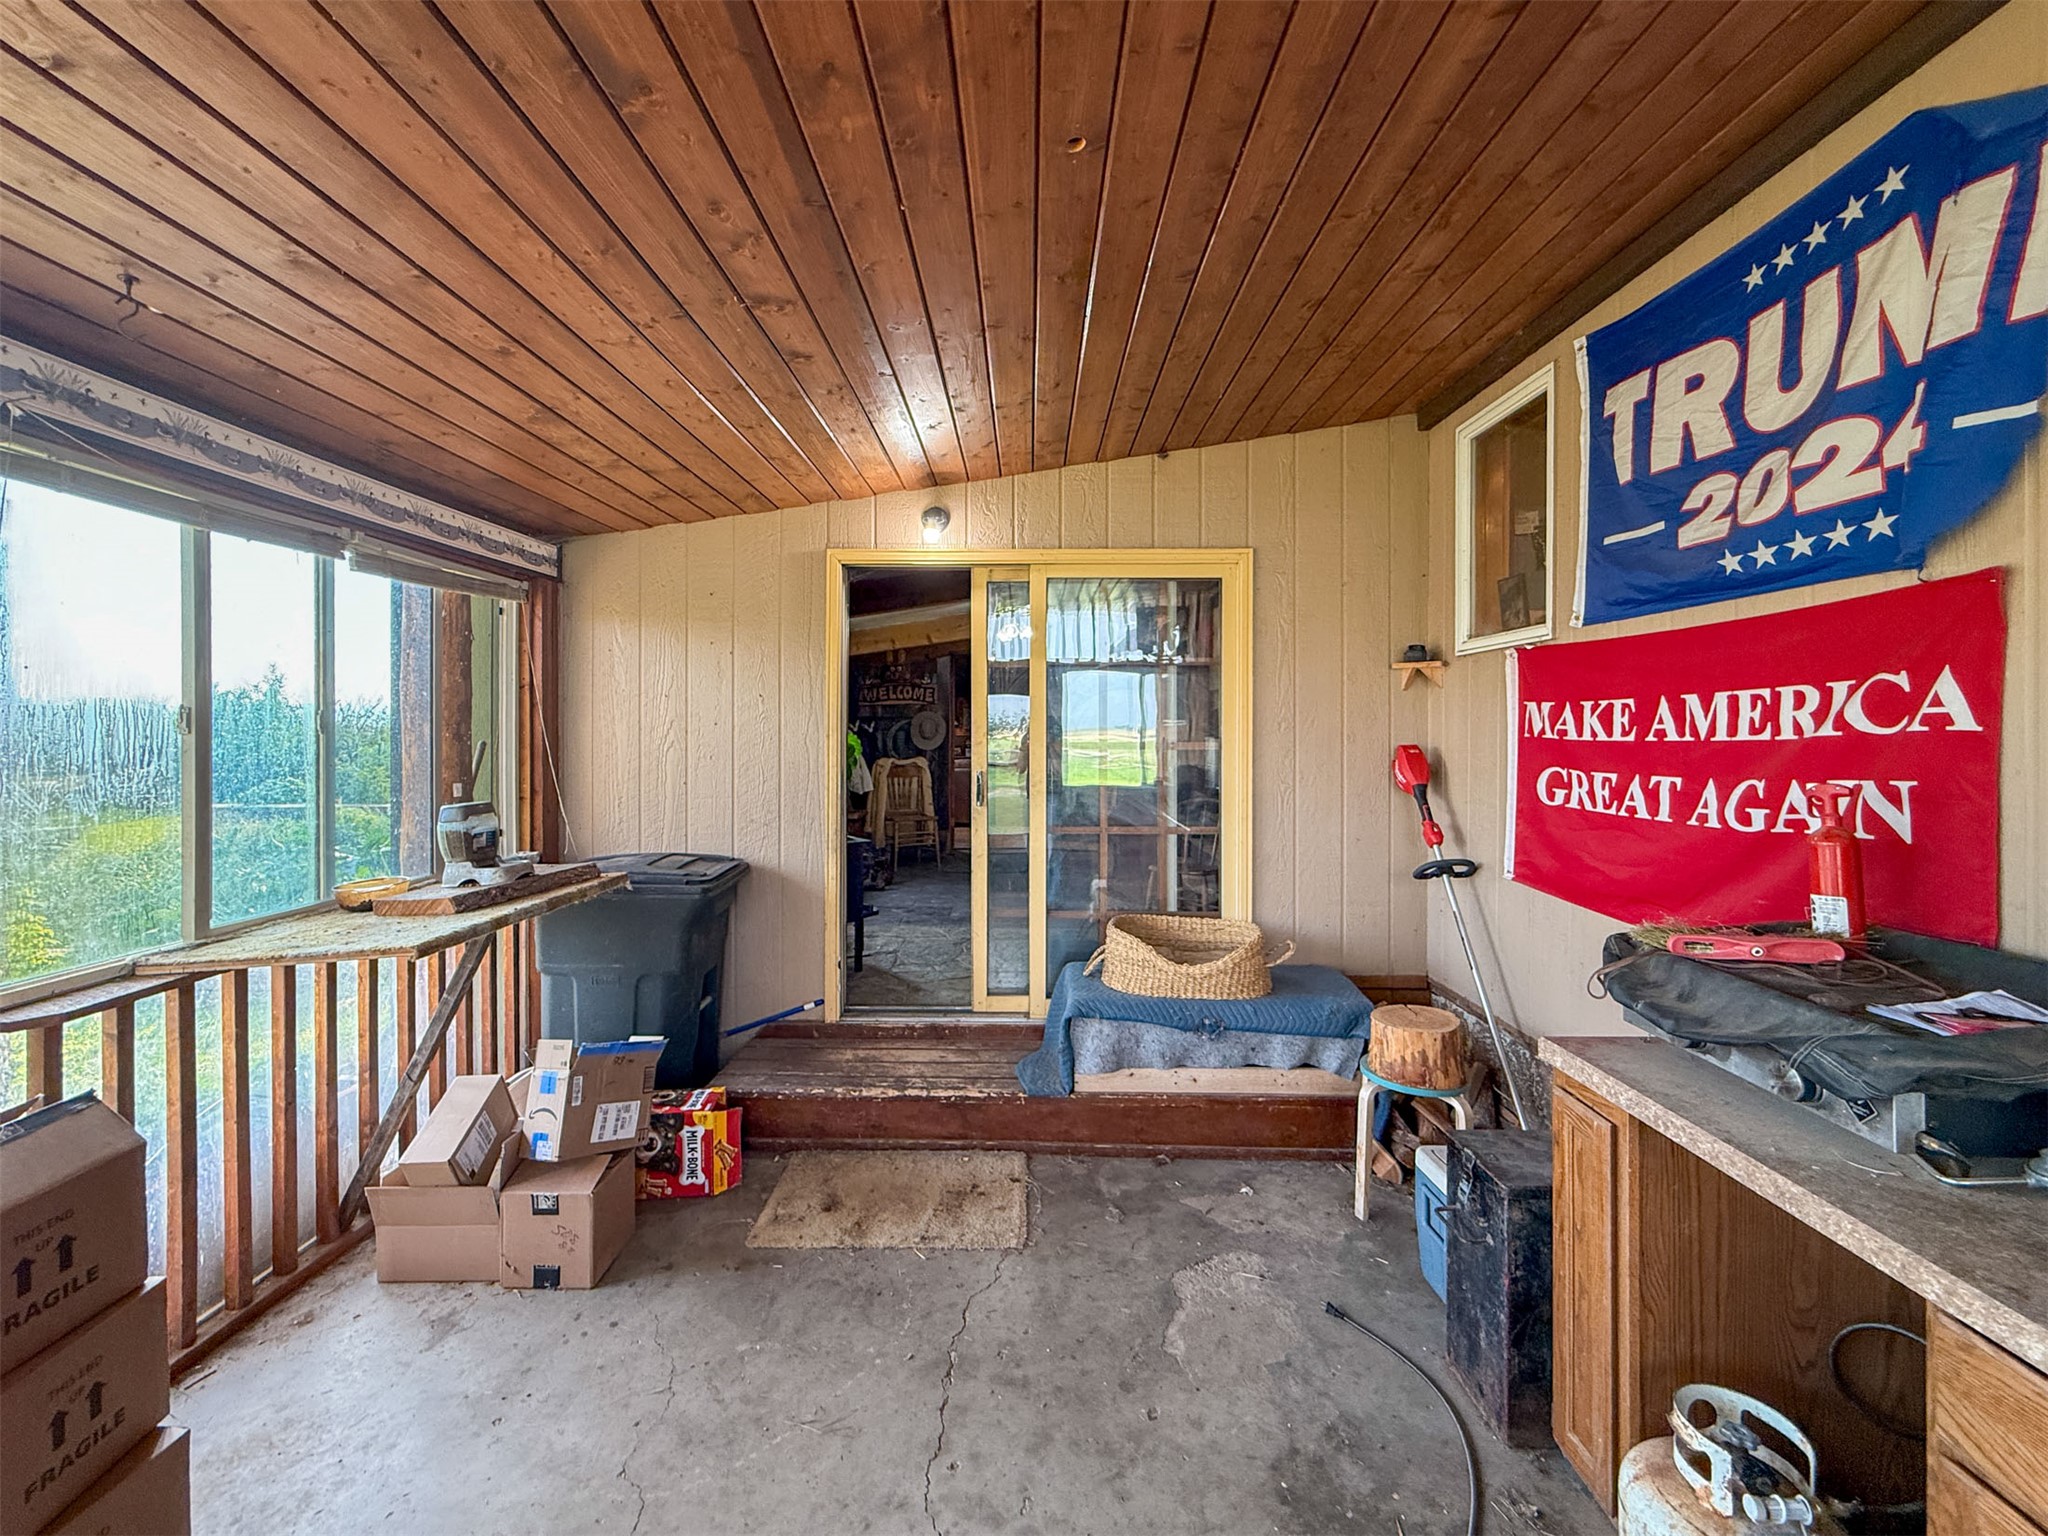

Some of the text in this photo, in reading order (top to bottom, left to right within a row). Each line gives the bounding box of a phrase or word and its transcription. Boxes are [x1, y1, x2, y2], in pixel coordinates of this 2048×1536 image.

[1604, 141, 2048, 485] TRUM
[863, 685, 935, 702] WELCOME
[1523, 664, 1983, 742] MAKE AMERICA
[1536, 766, 1681, 823] GREAT
[13, 1208, 75, 1247] THIS END
[35, 1236, 54, 1252] UP
[2, 1264, 100, 1336] RAGILE
[24, 1406, 126, 1505] FRAGILE
